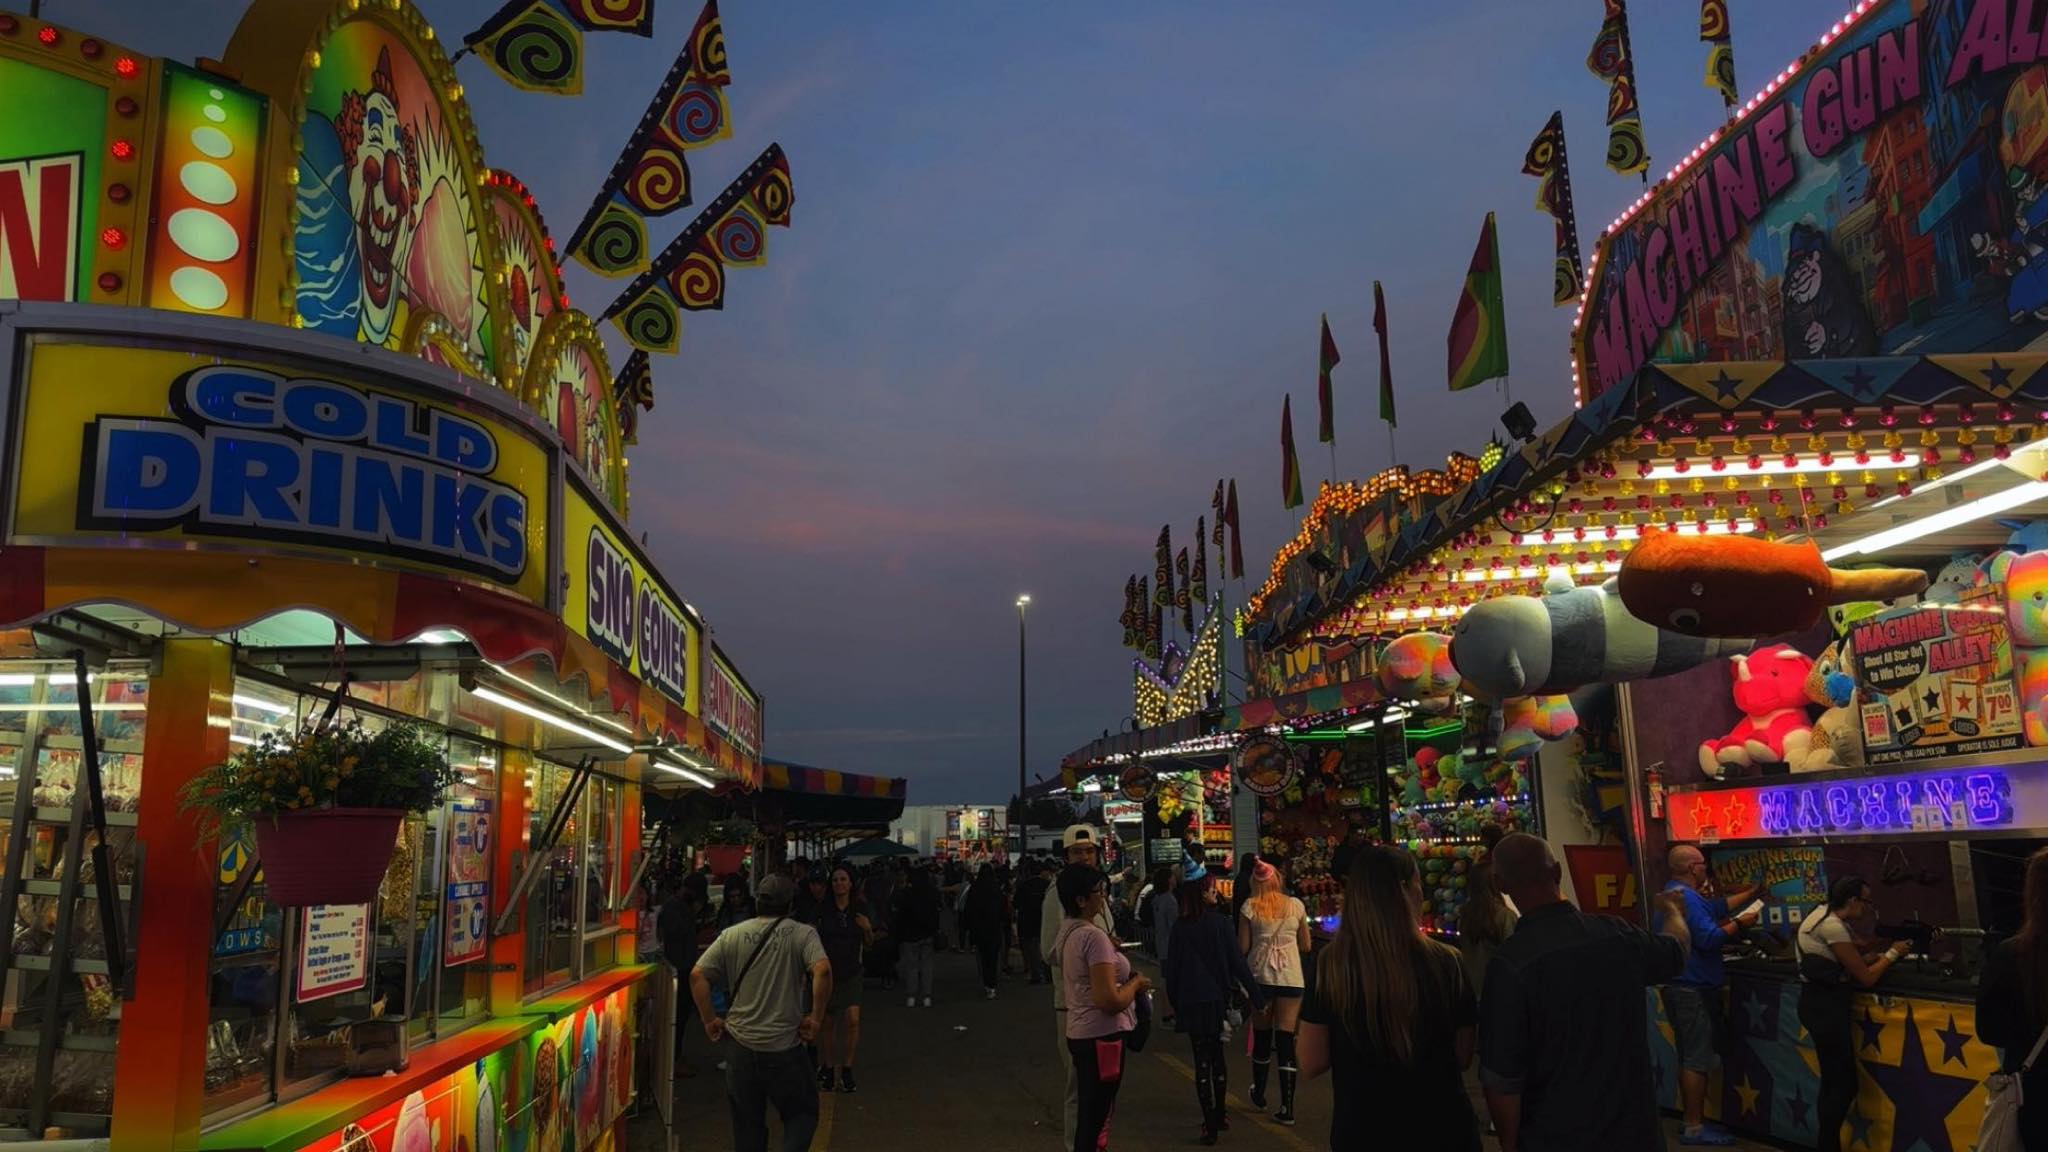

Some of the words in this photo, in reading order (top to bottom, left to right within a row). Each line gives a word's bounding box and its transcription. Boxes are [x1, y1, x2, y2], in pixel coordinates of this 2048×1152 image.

[1593, 102, 1795, 392] MACHINE
[1802, 20, 1921, 157] GUN
[1946, 0, 2048, 86] AL
[190, 369, 495, 474] COLD
[97, 423, 526, 574] DRINKS
[589, 533, 634, 653] SNO
[639, 586, 686, 696] CONES
[1854, 609, 1945, 655] MACHINE
[1895, 664, 1920, 679] Choice
[1929, 631, 1993, 673] ALLEY
[1759, 773, 1999, 830] MACHINE
[1791, 848, 1822, 862] GUN
[217, 930, 262, 952] OWS
